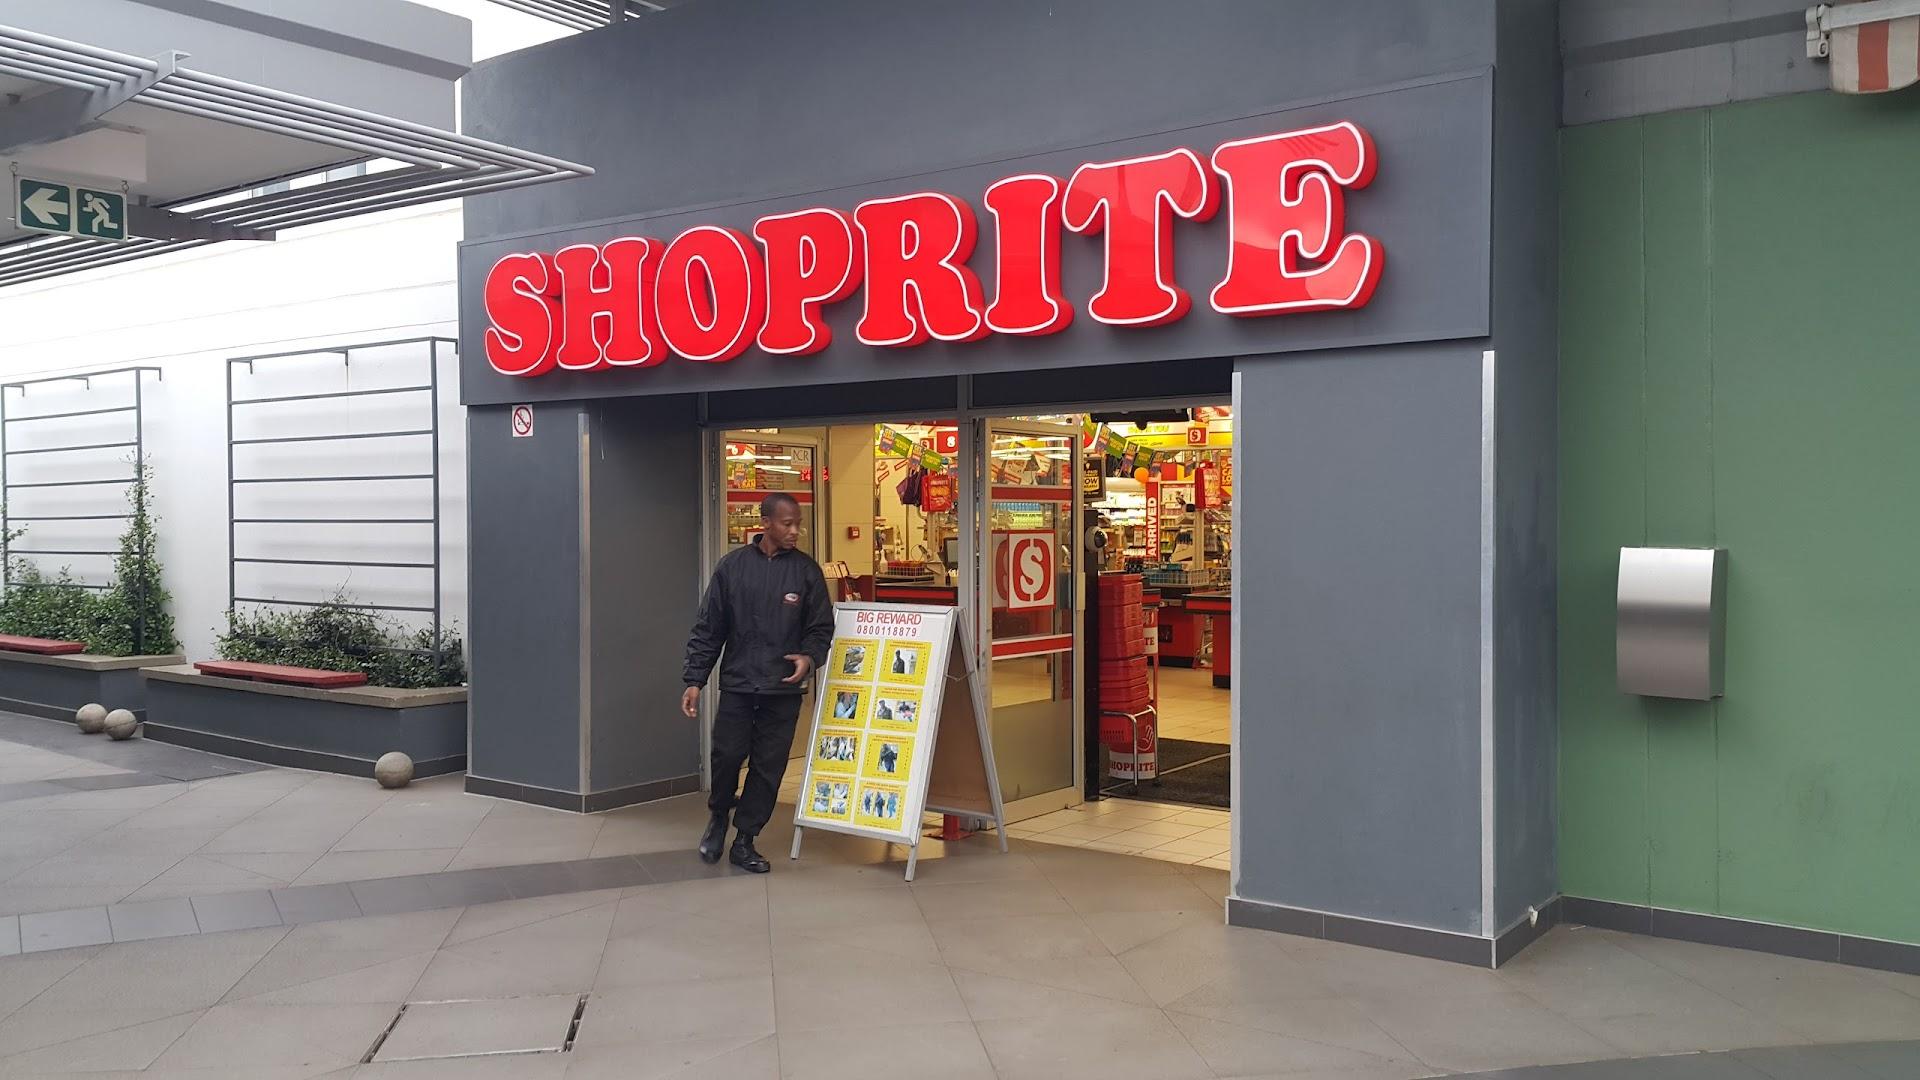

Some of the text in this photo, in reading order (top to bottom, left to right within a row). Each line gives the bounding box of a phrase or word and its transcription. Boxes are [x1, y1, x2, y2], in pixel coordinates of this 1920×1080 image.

[485, 121, 1385, 377] SHOPRITE
[946, 435, 956, 448] 8
[793, 449, 809, 461] NCR
[1147, 496, 1157, 557] ARRIVED
[856, 611, 922, 626] BIG REWARD
[856, 624, 917, 637] 0800118879
